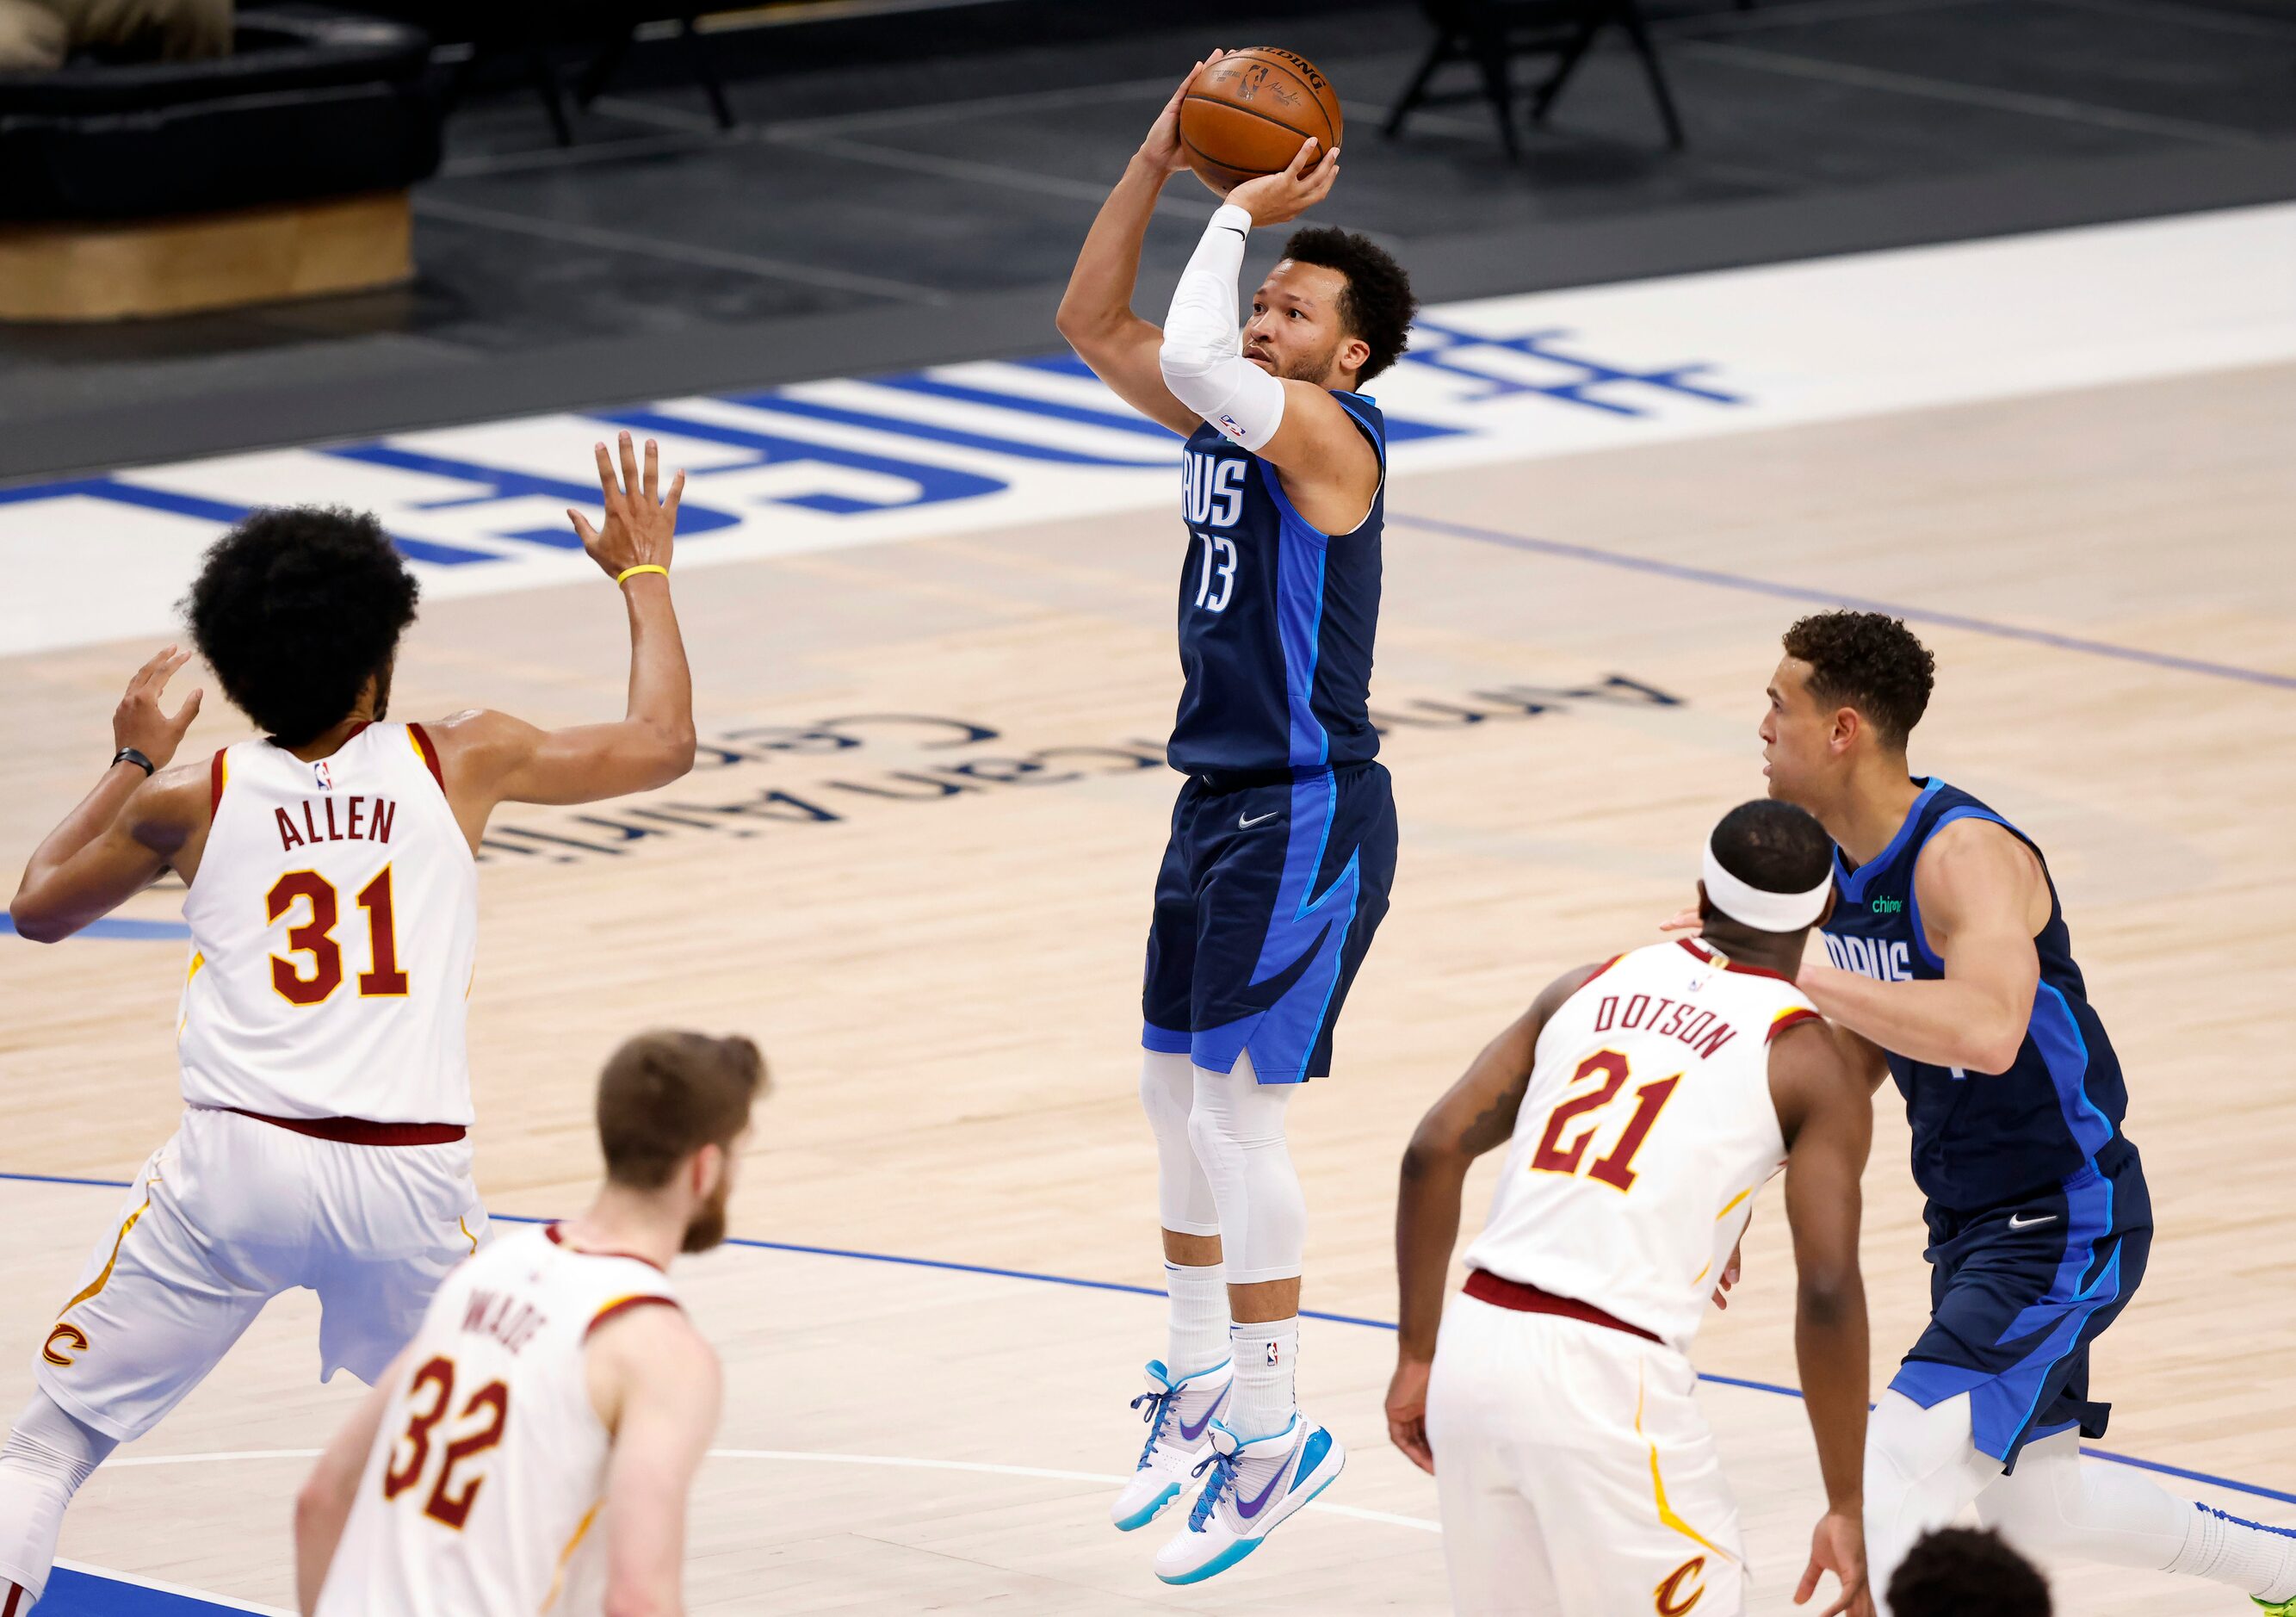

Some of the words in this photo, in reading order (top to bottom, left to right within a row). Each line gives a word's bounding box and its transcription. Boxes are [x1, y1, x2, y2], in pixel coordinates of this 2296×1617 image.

[1183, 448, 1248, 529] AVS
[1193, 532, 1238, 615] 13
[274, 796, 396, 852] ALLEN
[264, 860, 410, 1007] 31
[1594, 994, 1738, 1060] DOTSON
[1528, 1047, 1686, 1196] 21
[384, 1350, 511, 1531] 32
